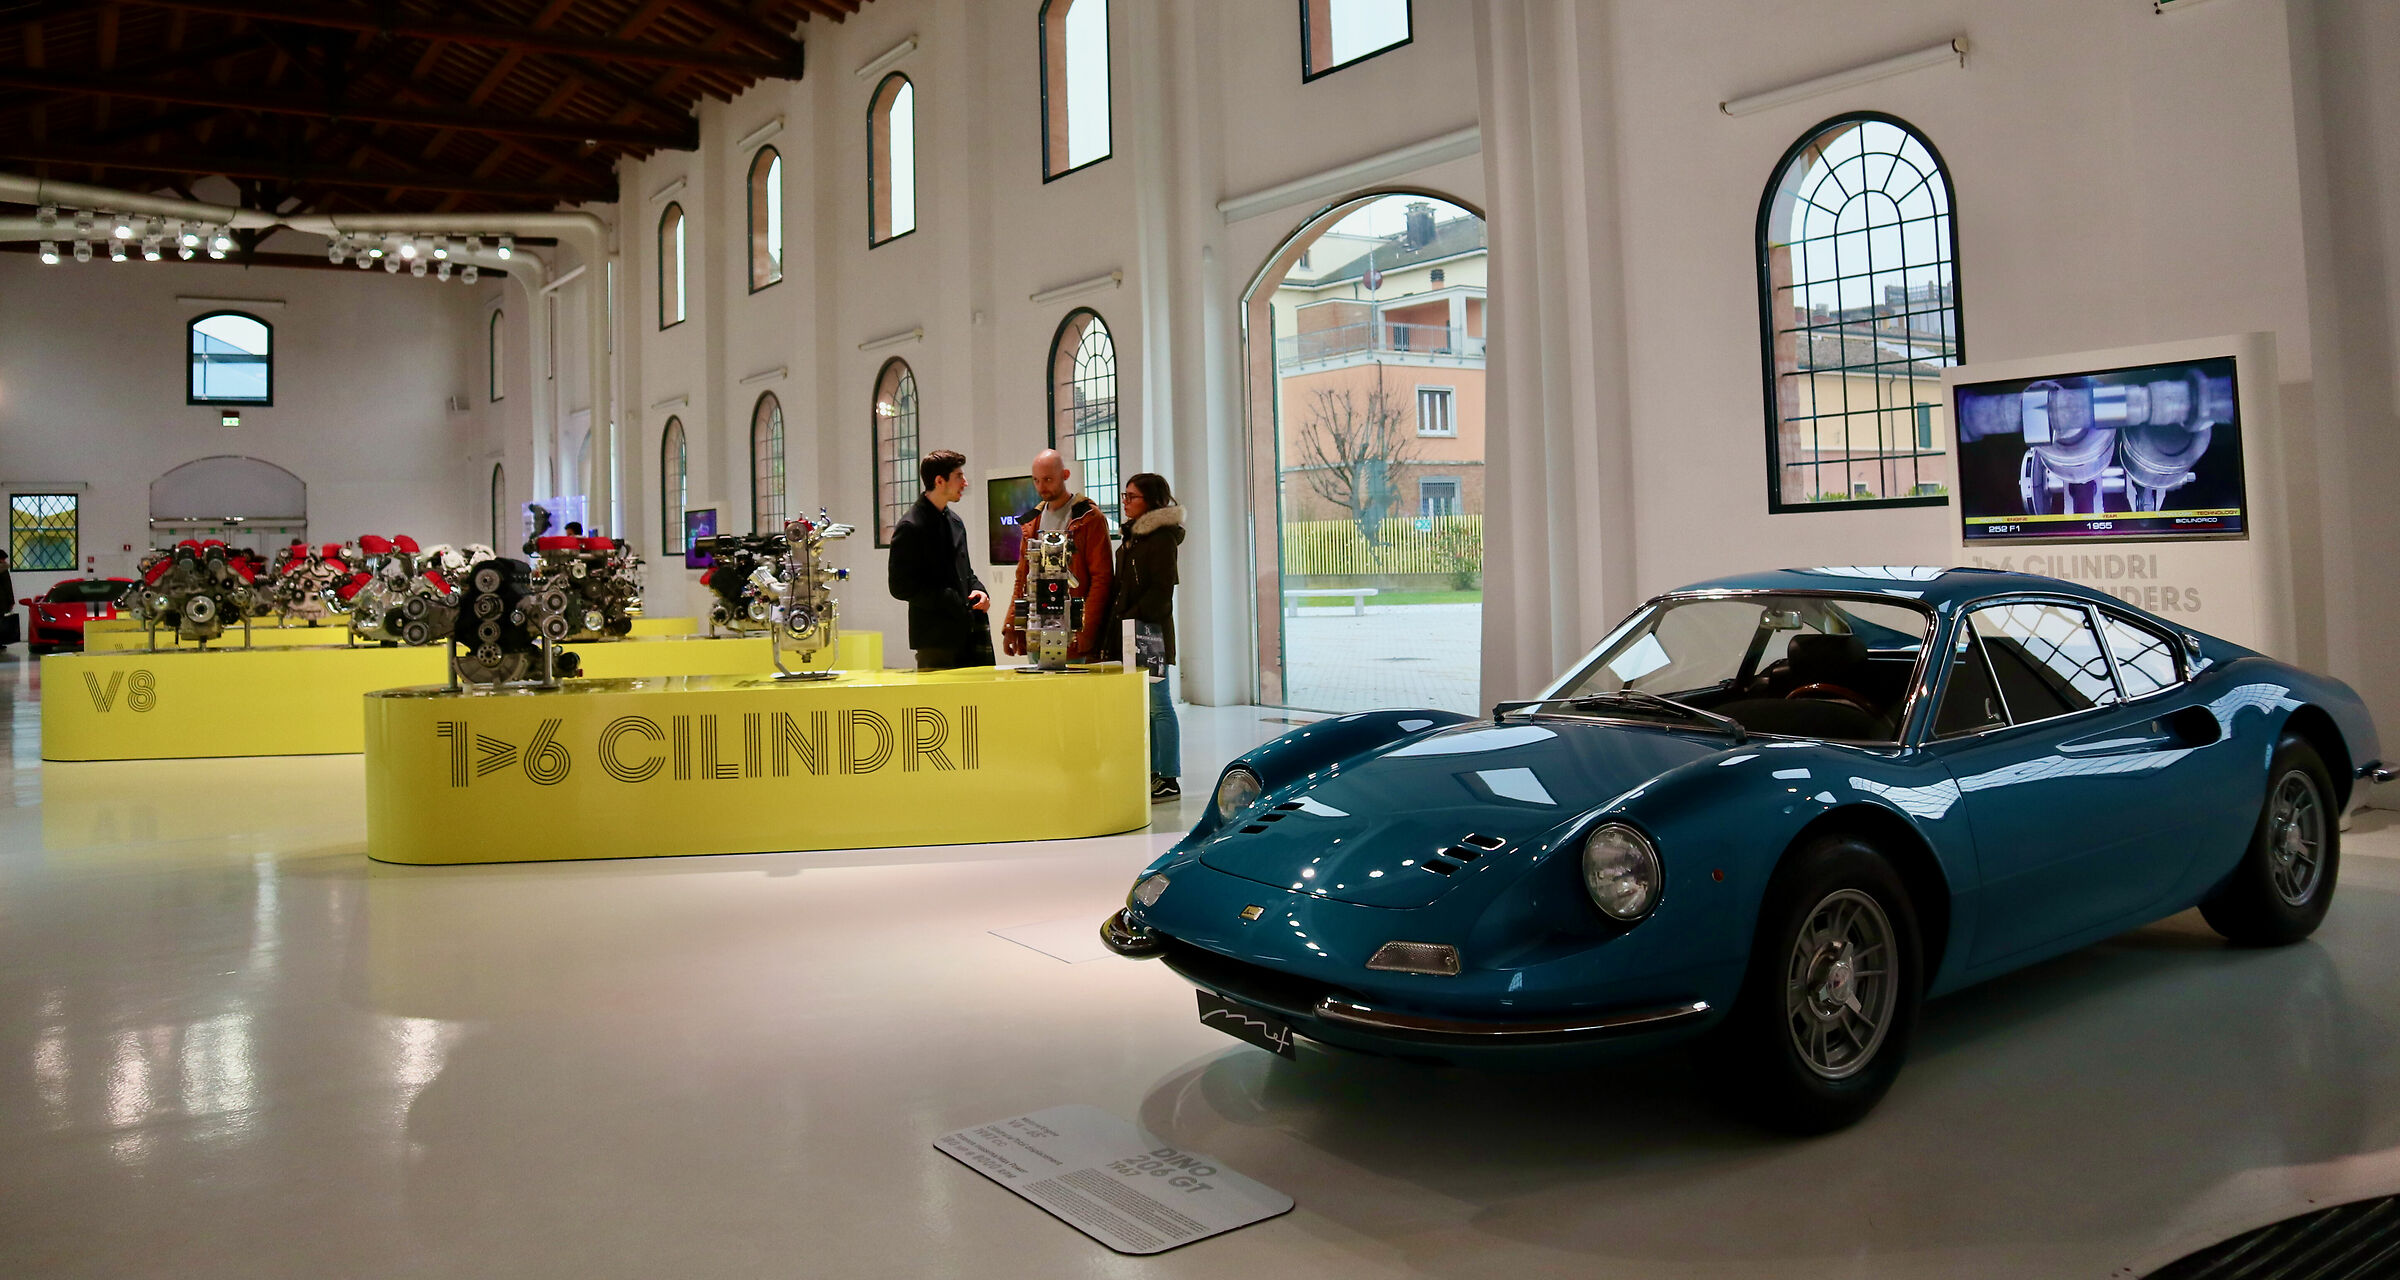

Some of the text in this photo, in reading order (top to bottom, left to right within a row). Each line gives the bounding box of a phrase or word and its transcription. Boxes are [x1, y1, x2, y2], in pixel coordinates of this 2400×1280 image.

[1988, 524, 2020, 533] 252 F1
[2086, 522, 2113, 530] 1955
[2023, 554, 2158, 580] CILINDRI
[83, 669, 156, 713] V8
[598, 705, 979, 783] CILINDRI
[1105, 1160, 1142, 1177] 1967
[1122, 1154, 1214, 1193] 206 GT
[1149, 1148, 1218, 1177] DINO
